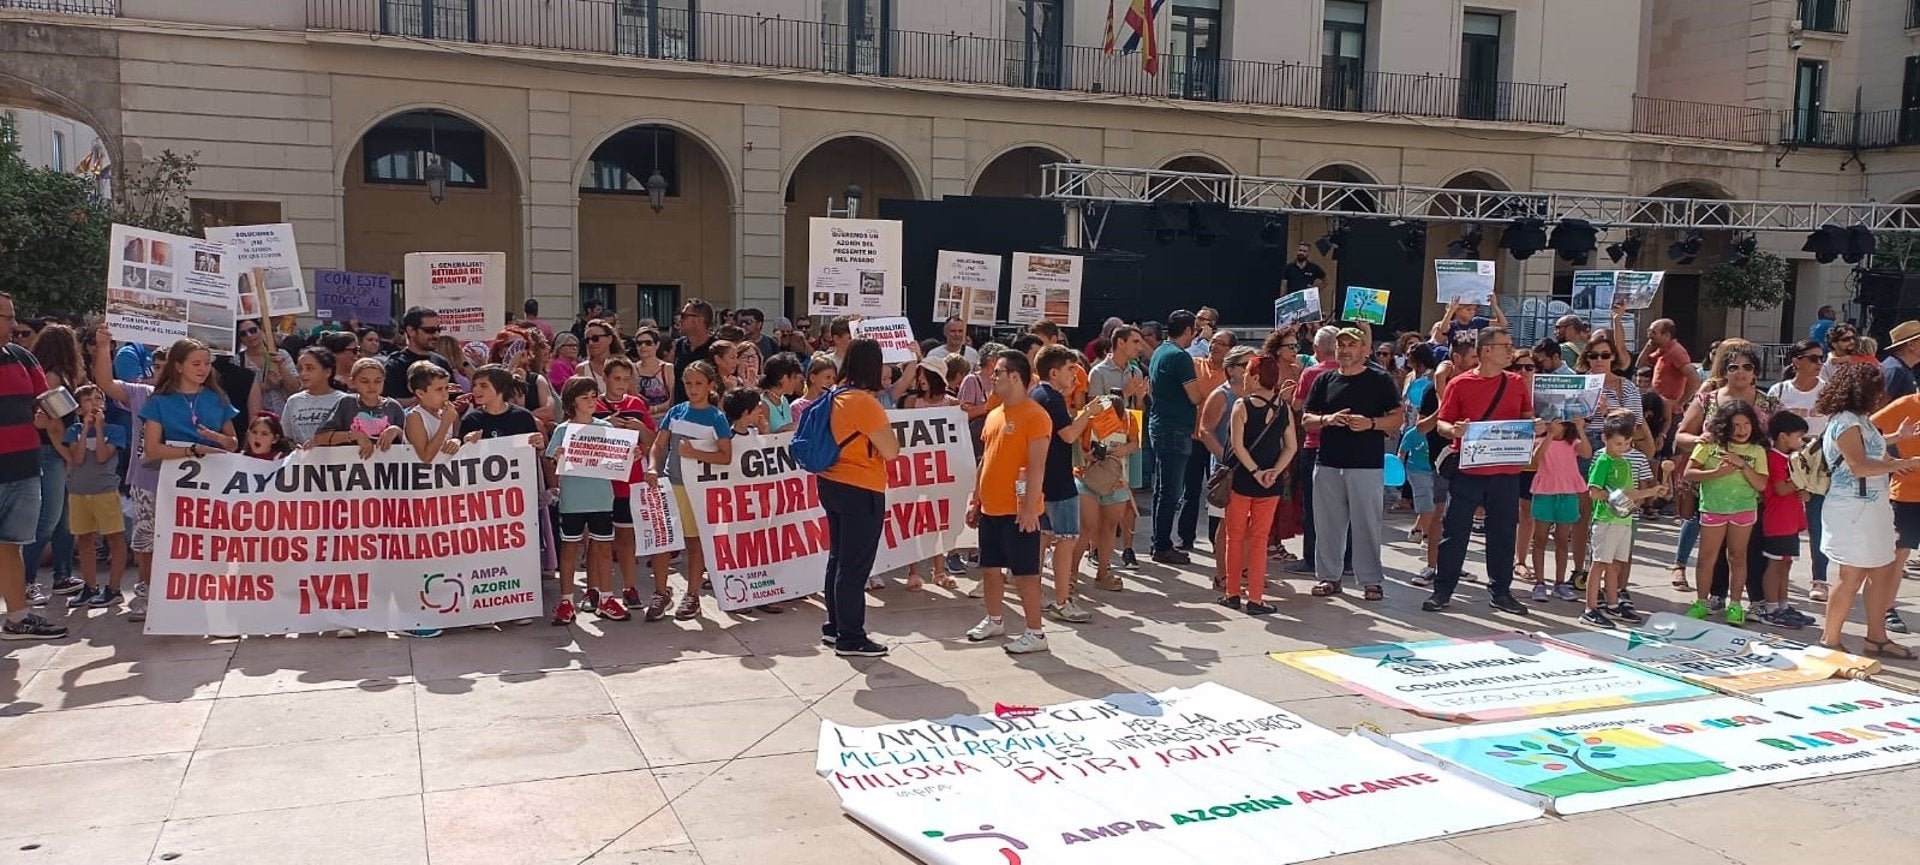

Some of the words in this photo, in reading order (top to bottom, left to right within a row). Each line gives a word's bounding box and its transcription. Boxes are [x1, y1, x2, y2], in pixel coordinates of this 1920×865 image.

[324, 273, 350, 284] CON
[358, 276, 386, 288] ESTE
[322, 293, 360, 306] TODOS
[175, 461, 210, 490] 2.
[222, 454, 520, 494] AYUNTAMIENTO:
[174, 486, 525, 532] REACONDICIONAMIENTO
[170, 533, 204, 560] DE
[210, 534, 308, 563] PATIOS
[315, 536, 328, 562] E
[332, 522, 526, 562] INSTALACIONES
[713, 514, 830, 572] AMIAN
[471, 566, 508, 580] AMPA
[746, 570, 768, 579] AMPA
[166, 572, 276, 602] DIGNAS
[298, 573, 370, 615] ¡YA!
[472, 579, 520, 595] AZORIN
[752, 586, 785, 599] ALICANTE
[473, 592, 534, 609] ALICANTE
[984, 716, 1049, 734] DEL
[1180, 712, 1218, 724] LA
[834, 760, 982, 791] MILLORA
[990, 752, 1034, 768] DE
[1042, 744, 1094, 767] LES
[1738, 760, 1788, 772] Plan
[1060, 820, 1166, 845] AMPA
[1170, 794, 1294, 826] AZORÍN
[1296, 772, 1439, 804] ALICANTE
